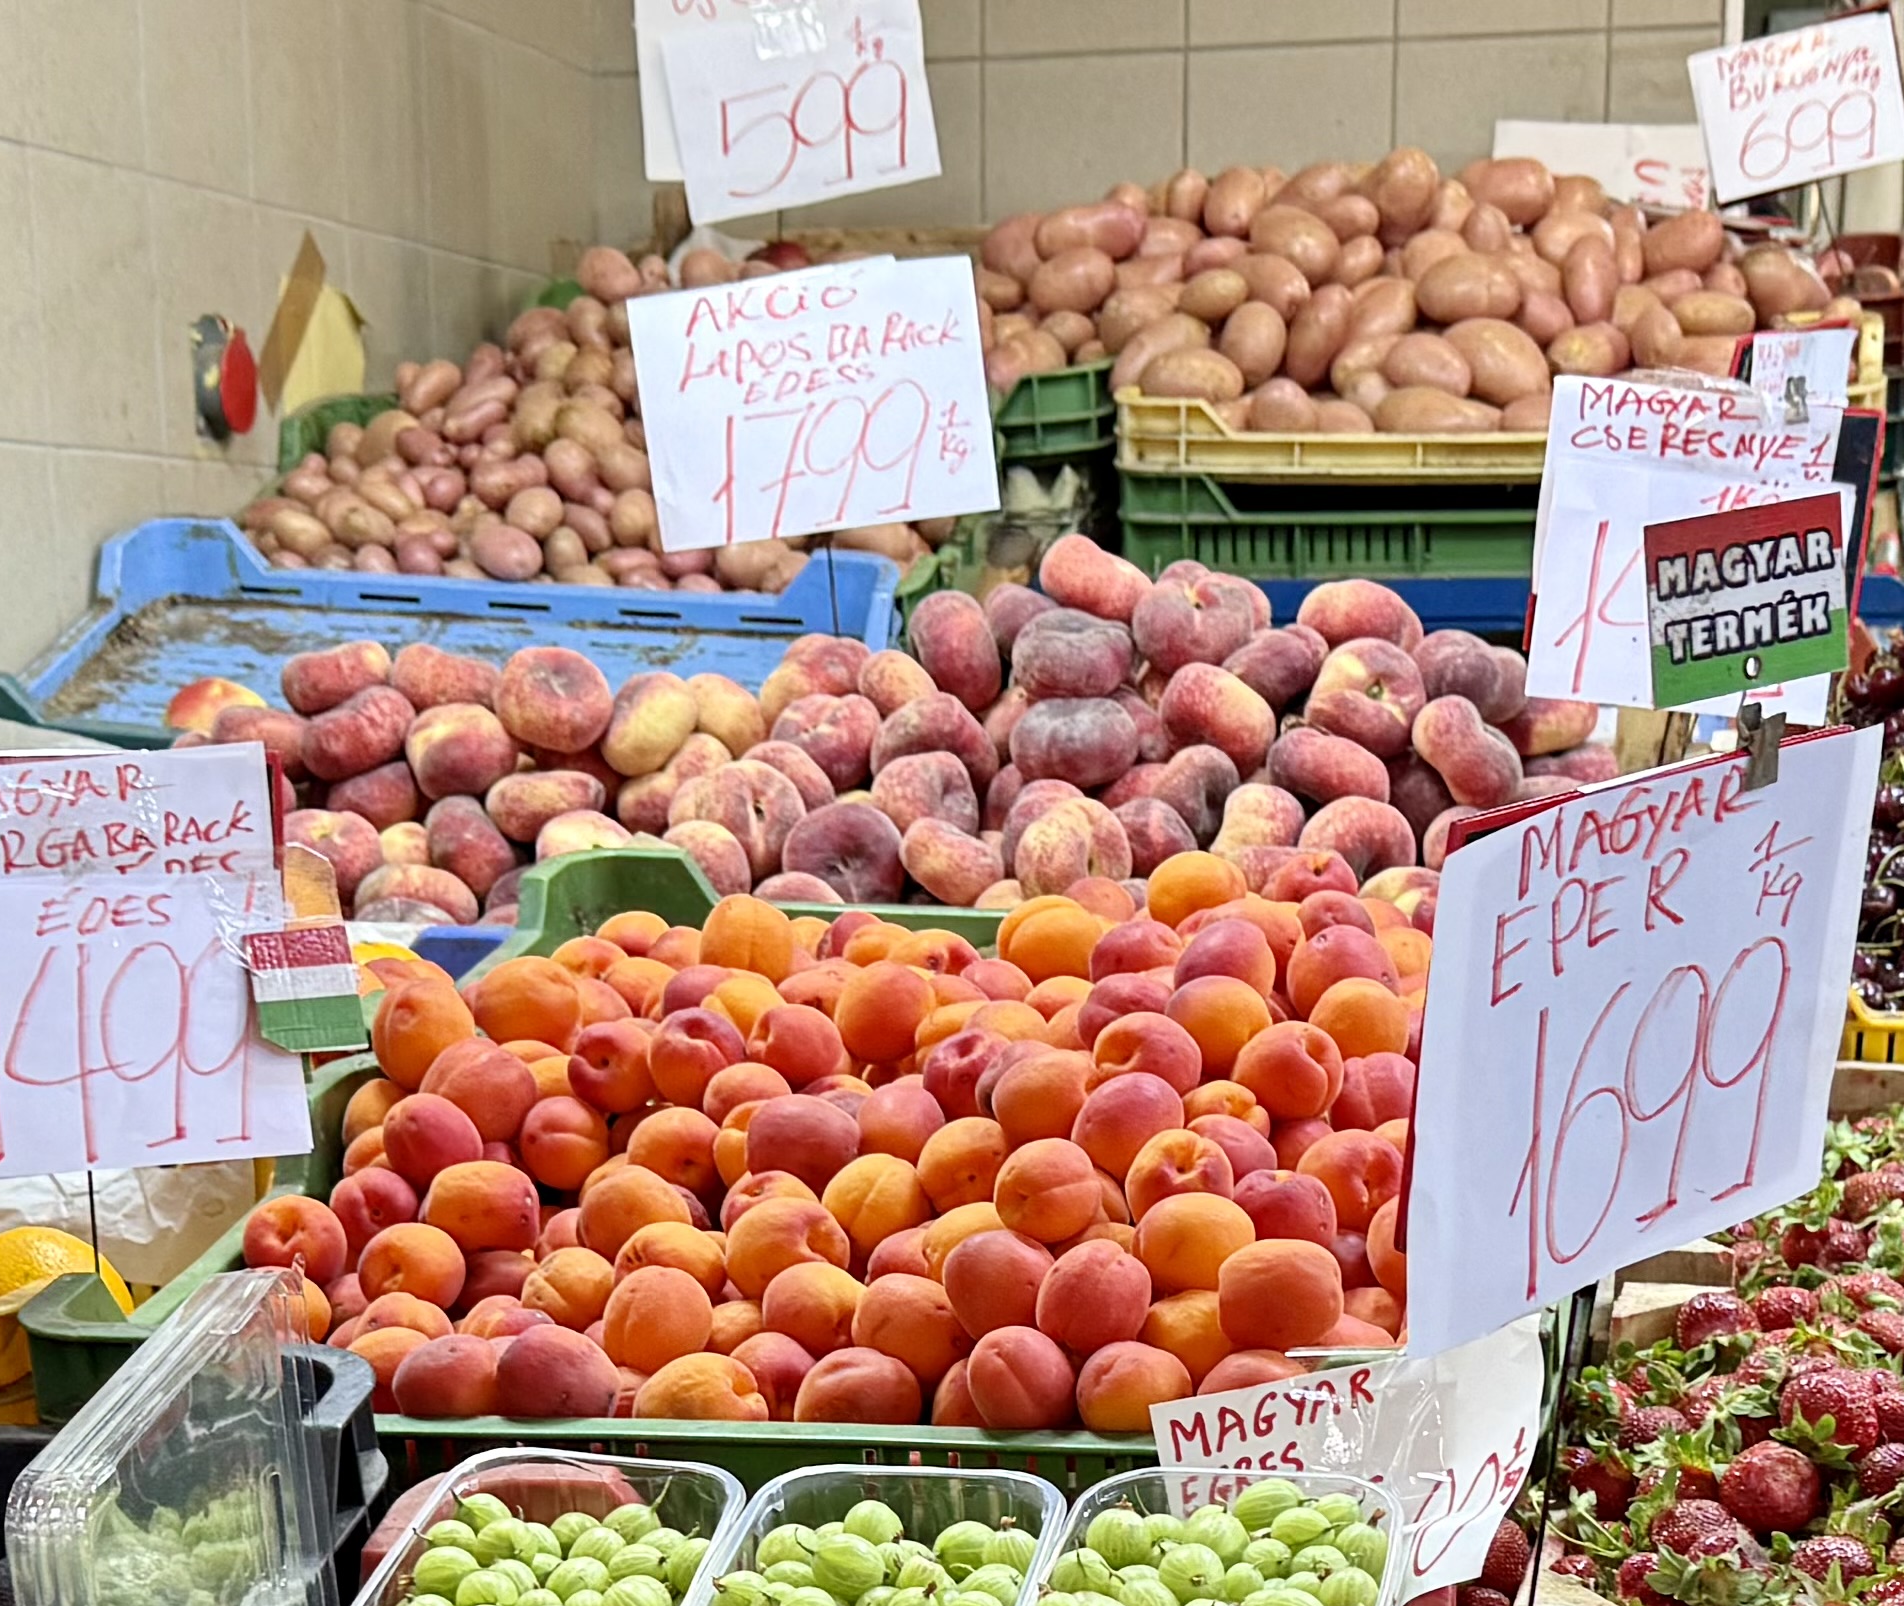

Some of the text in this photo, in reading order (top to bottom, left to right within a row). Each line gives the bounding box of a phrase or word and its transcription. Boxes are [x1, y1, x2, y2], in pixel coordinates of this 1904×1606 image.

[720, 59, 907, 198] 599
[1739, 90, 1877, 182] 699
[1570, 423, 1807, 472] CSERESNYE
[1578, 382, 1760, 421] MAGYAR
[712, 378, 931, 544] 1799
[1656, 527, 1835, 601] MAGYAR
[1664, 590, 1832, 664] TERMÉK
[1518, 763, 1759, 900] MAGYAR
[36, 886, 173, 937] ÉDES
[1491, 847, 1686, 1007] EPER
[1509, 936, 1791, 1301] 1699
[1169, 1368, 1375, 1463] MAGYAR
